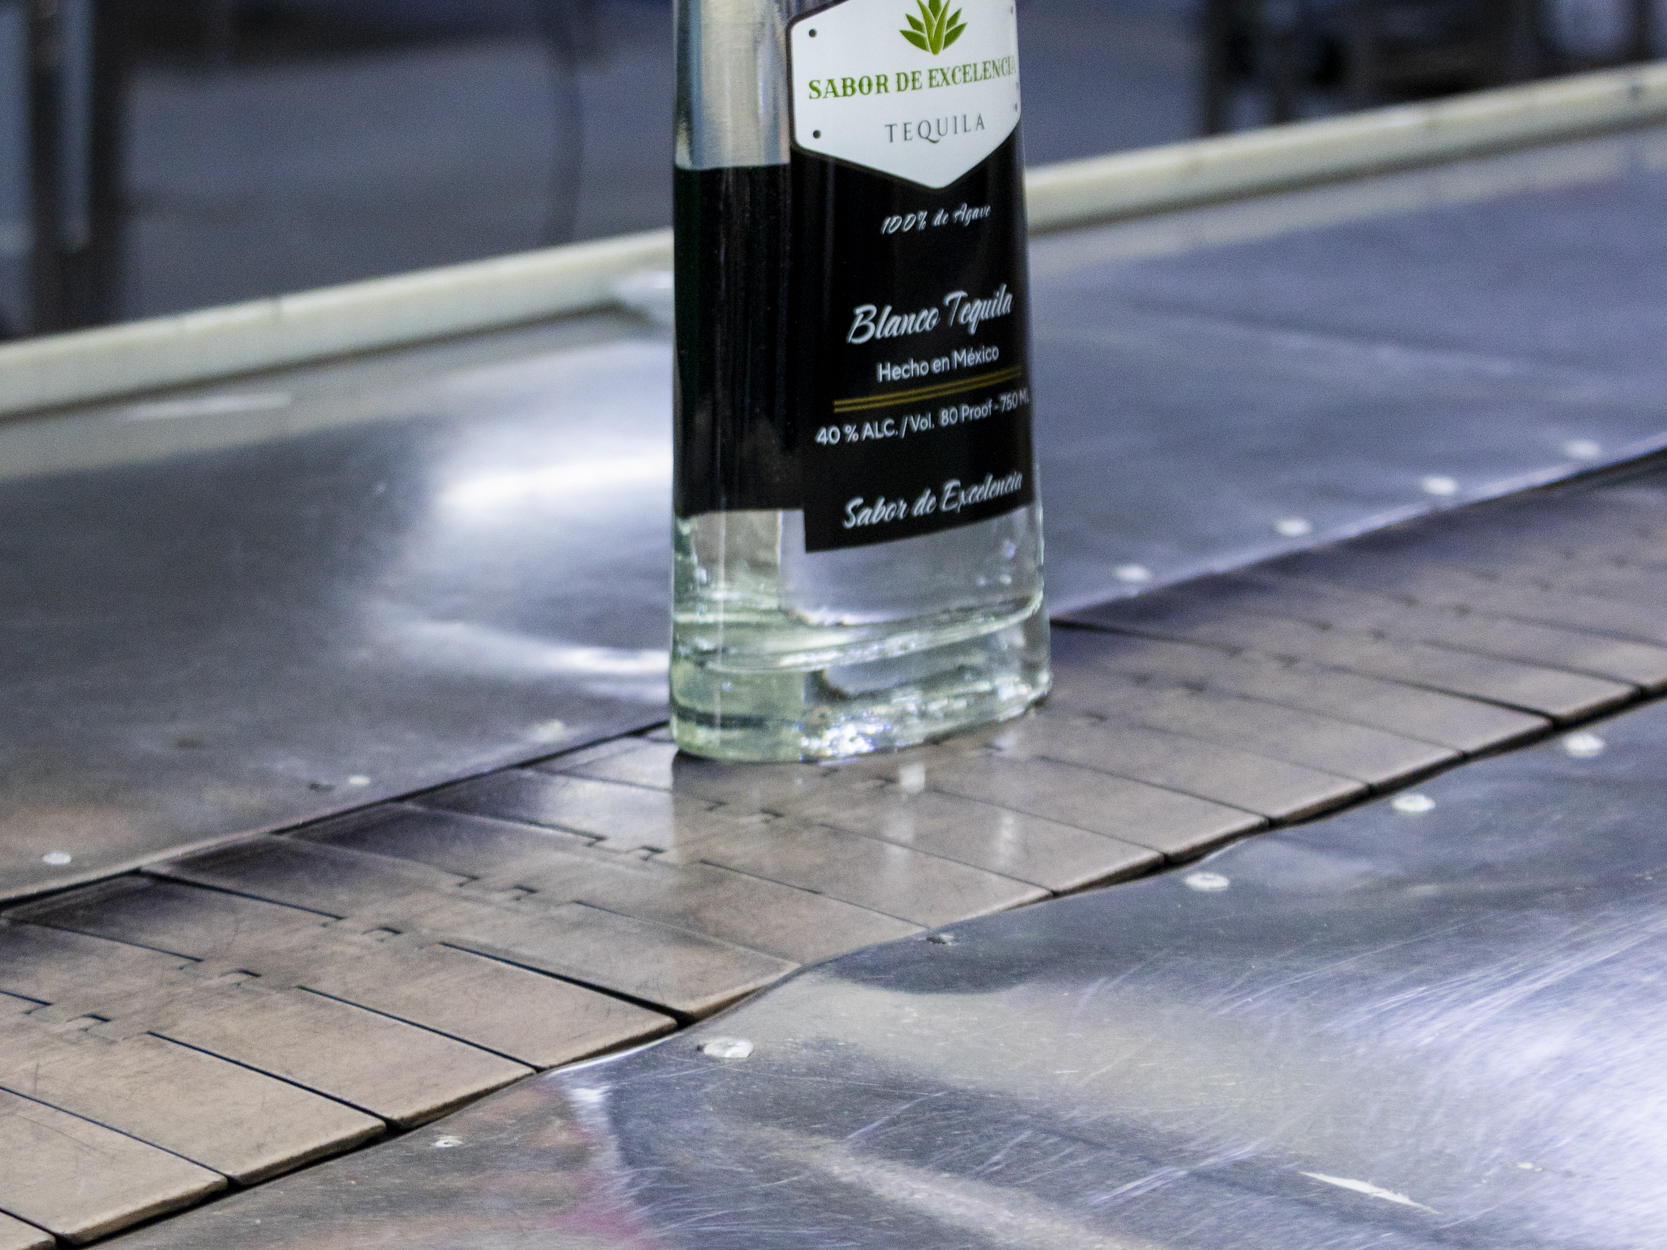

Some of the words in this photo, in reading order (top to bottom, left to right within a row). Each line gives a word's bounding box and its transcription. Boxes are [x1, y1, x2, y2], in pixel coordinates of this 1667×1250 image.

[808, 73, 890, 100] SABOR
[895, 69, 923, 93] DE
[928, 55, 1017, 88] EXCELENCIA
[884, 112, 986, 144] TEQUILA
[880, 209, 928, 235] 100%
[932, 206, 950, 228] de
[953, 202, 991, 229] Agave
[846, 303, 941, 345] Blanco
[943, 283, 1014, 335] Tequila
[876, 360, 930, 383] Hecho
[932, 357, 950, 376] en
[953, 344, 1000, 370] México
[815, 424, 841, 446] 40
[844, 423, 859, 443] %
[939, 408, 959, 428] 80
[961, 398, 993, 423] Proof
[1000, 391, 1018, 413] 750
[842, 494, 909, 529] Sabor
[912, 491, 938, 516] de
[941, 471, 1022, 512] Excelencia
